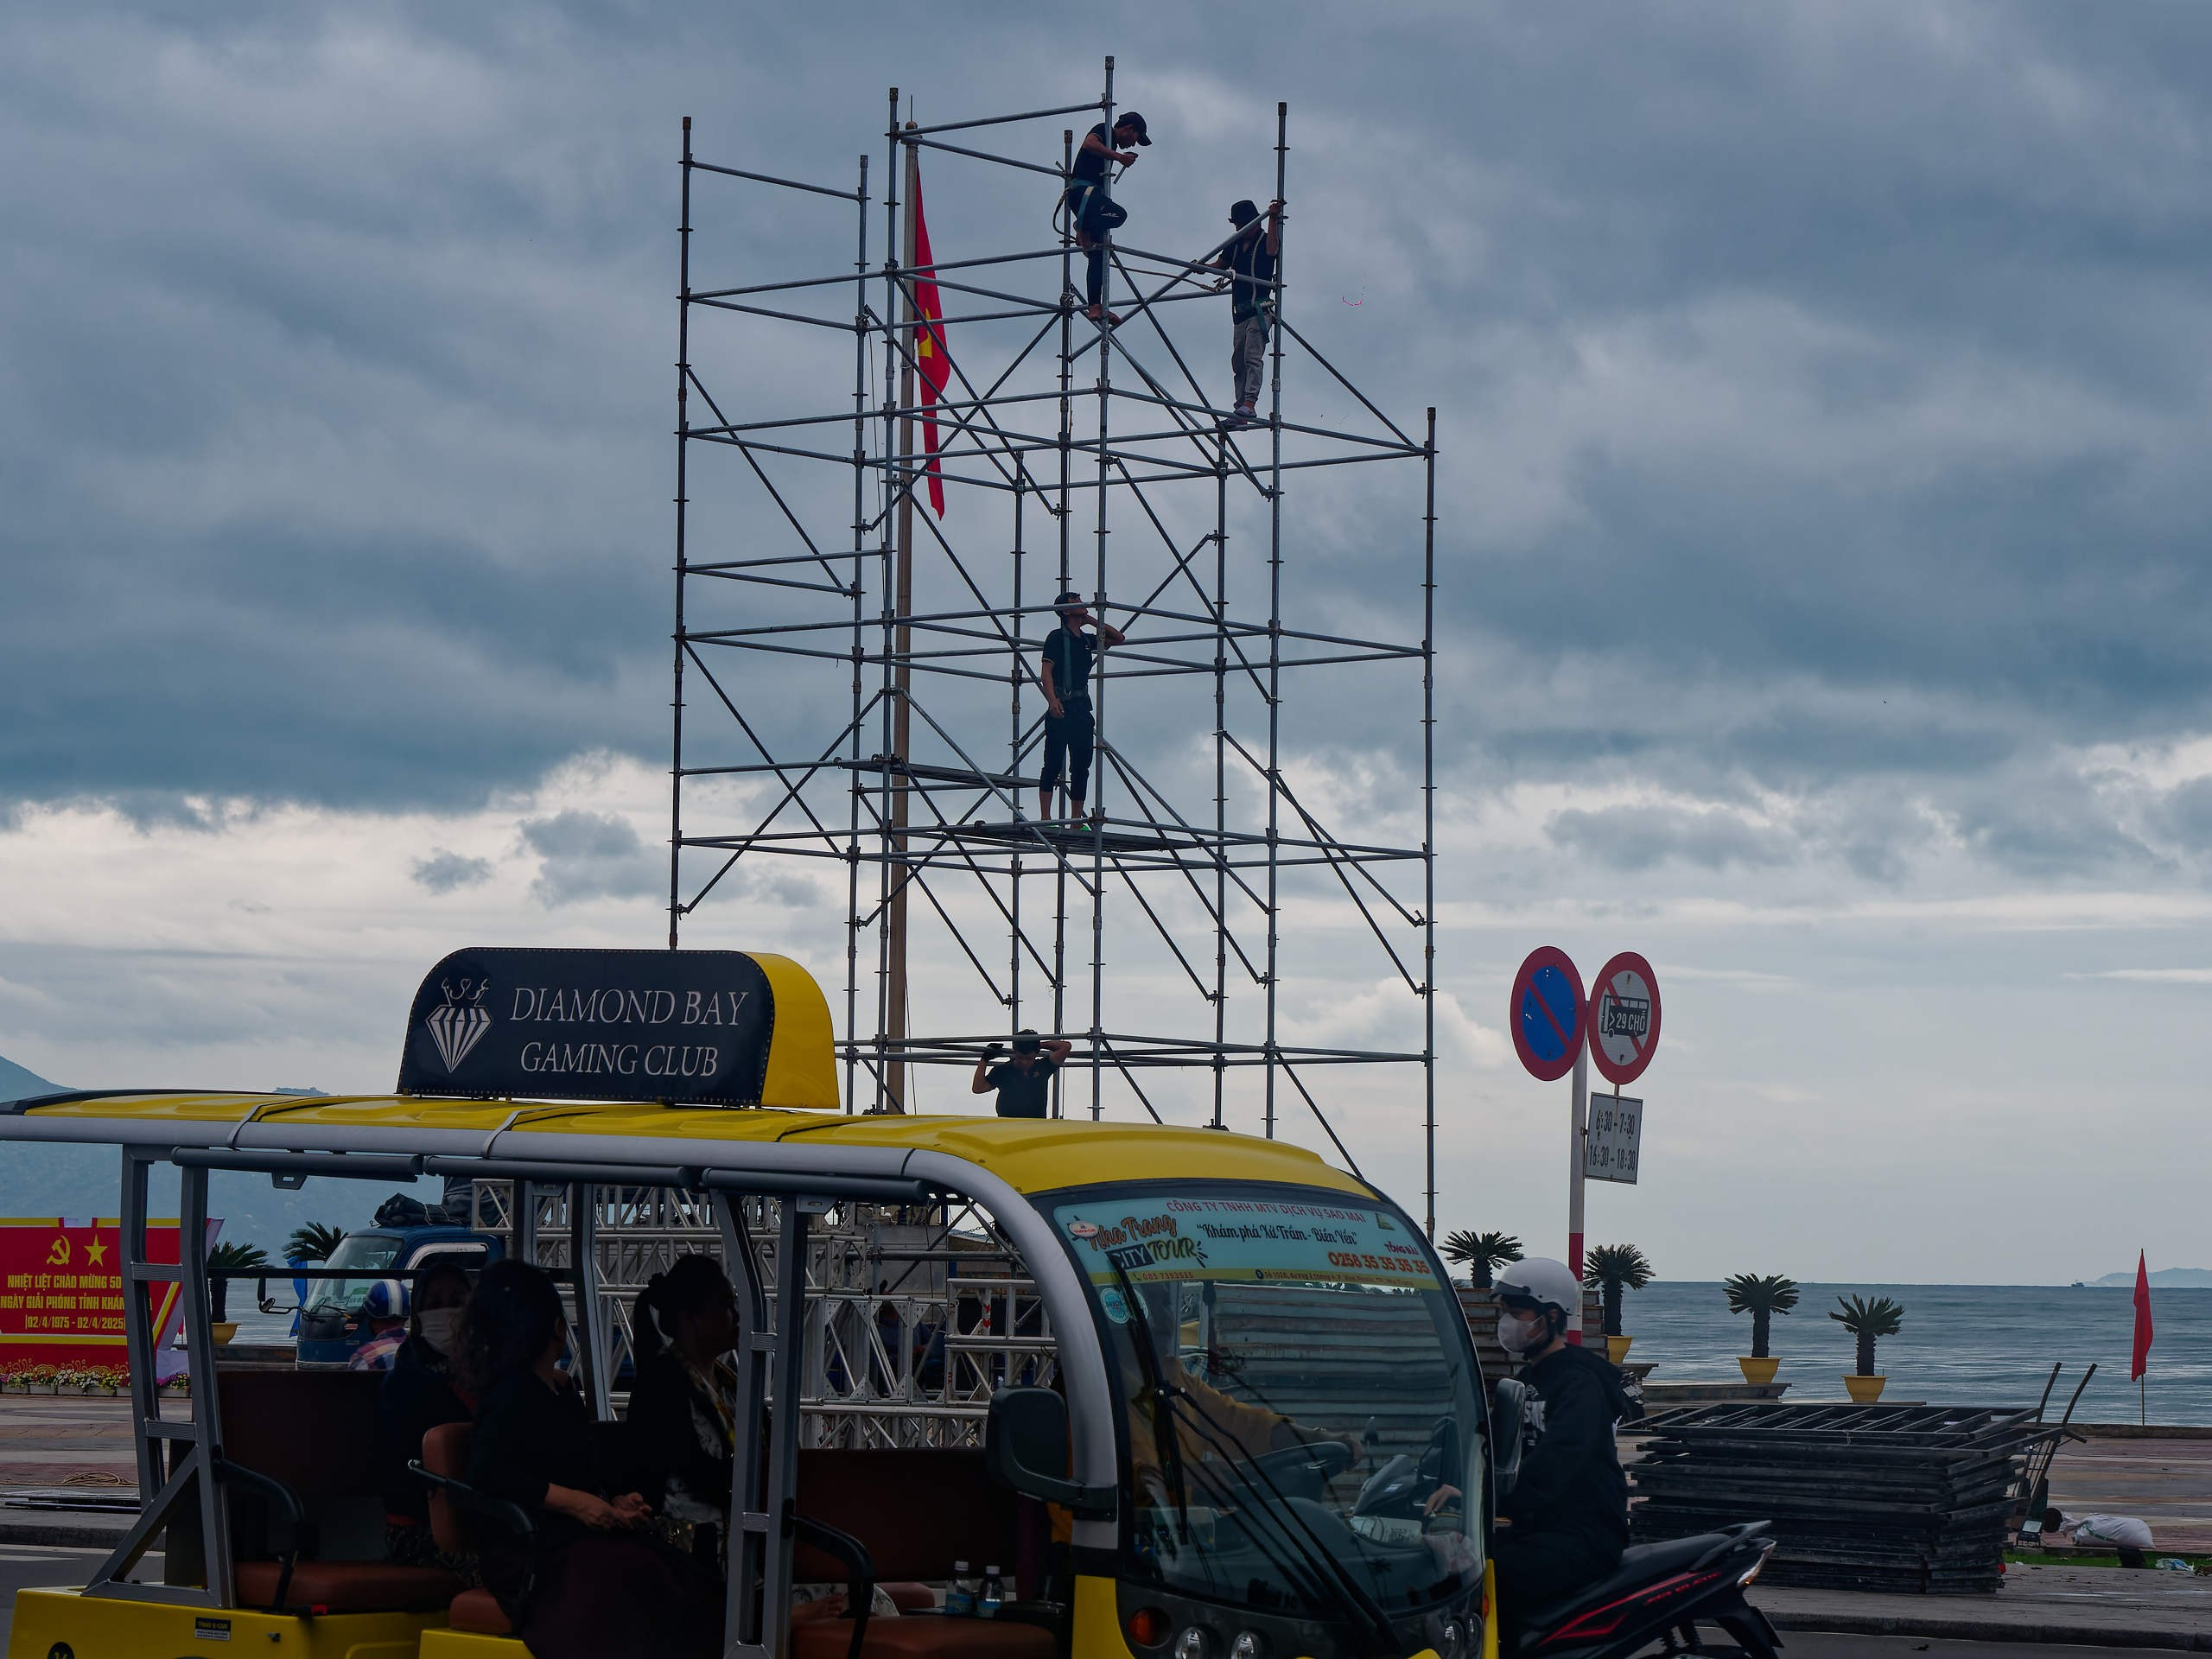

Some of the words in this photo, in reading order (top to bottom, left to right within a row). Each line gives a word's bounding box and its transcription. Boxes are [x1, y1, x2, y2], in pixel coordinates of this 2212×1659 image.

[509, 987, 677, 1025] DIAMOND
[680, 989, 749, 1027] BAY
[1616, 1012, 1627, 1029] 29
[1628, 1009, 1646, 1032] CHỖ
[520, 1041, 641, 1074] GAMING
[644, 1044, 718, 1077] CLUB
[1619, 1113, 1635, 1135] 7:30
[1590, 1144, 1609, 1167] 16:30
[1617, 1147, 1636, 1171] 18:30
[1166, 1199, 1202, 1212] CÔNG
[1203, 1202, 1217, 1211] TY
[1219, 1202, 1252, 1211] TNHH
[1255, 1203, 1278, 1214] MTV
[1281, 1205, 1306, 1217] DỊCH
[1345, 1212, 1367, 1223] MAI
[1089, 1224, 1127, 1251] Nha
[1121, 1214, 1178, 1241] Trang
[1238, 1224, 1262, 1242] phá
[1147, 1236, 1198, 1262] TOUR
[1328, 1251, 1362, 1268] 0258
[1361, 1254, 1380, 1270] 35
[1377, 1255, 1396, 1271] 35
[1395, 1257, 1414, 1273] 35
[1413, 1260, 1431, 1274] 35
[8, 1273, 33, 1291] NHIỆT
[35, 1273, 52, 1291] LIỆT
[54, 1273, 77, 1288] CHÀO
[79, 1273, 107, 1288] MỪNG
[110, 1275, 122, 1288] 50
[0, 1294, 24, 1309] NGÀY
[26, 1293, 43, 1309] GIẢI
[46, 1294, 76, 1309] PHÓNG
[79, 1293, 99, 1310] TỈNH
